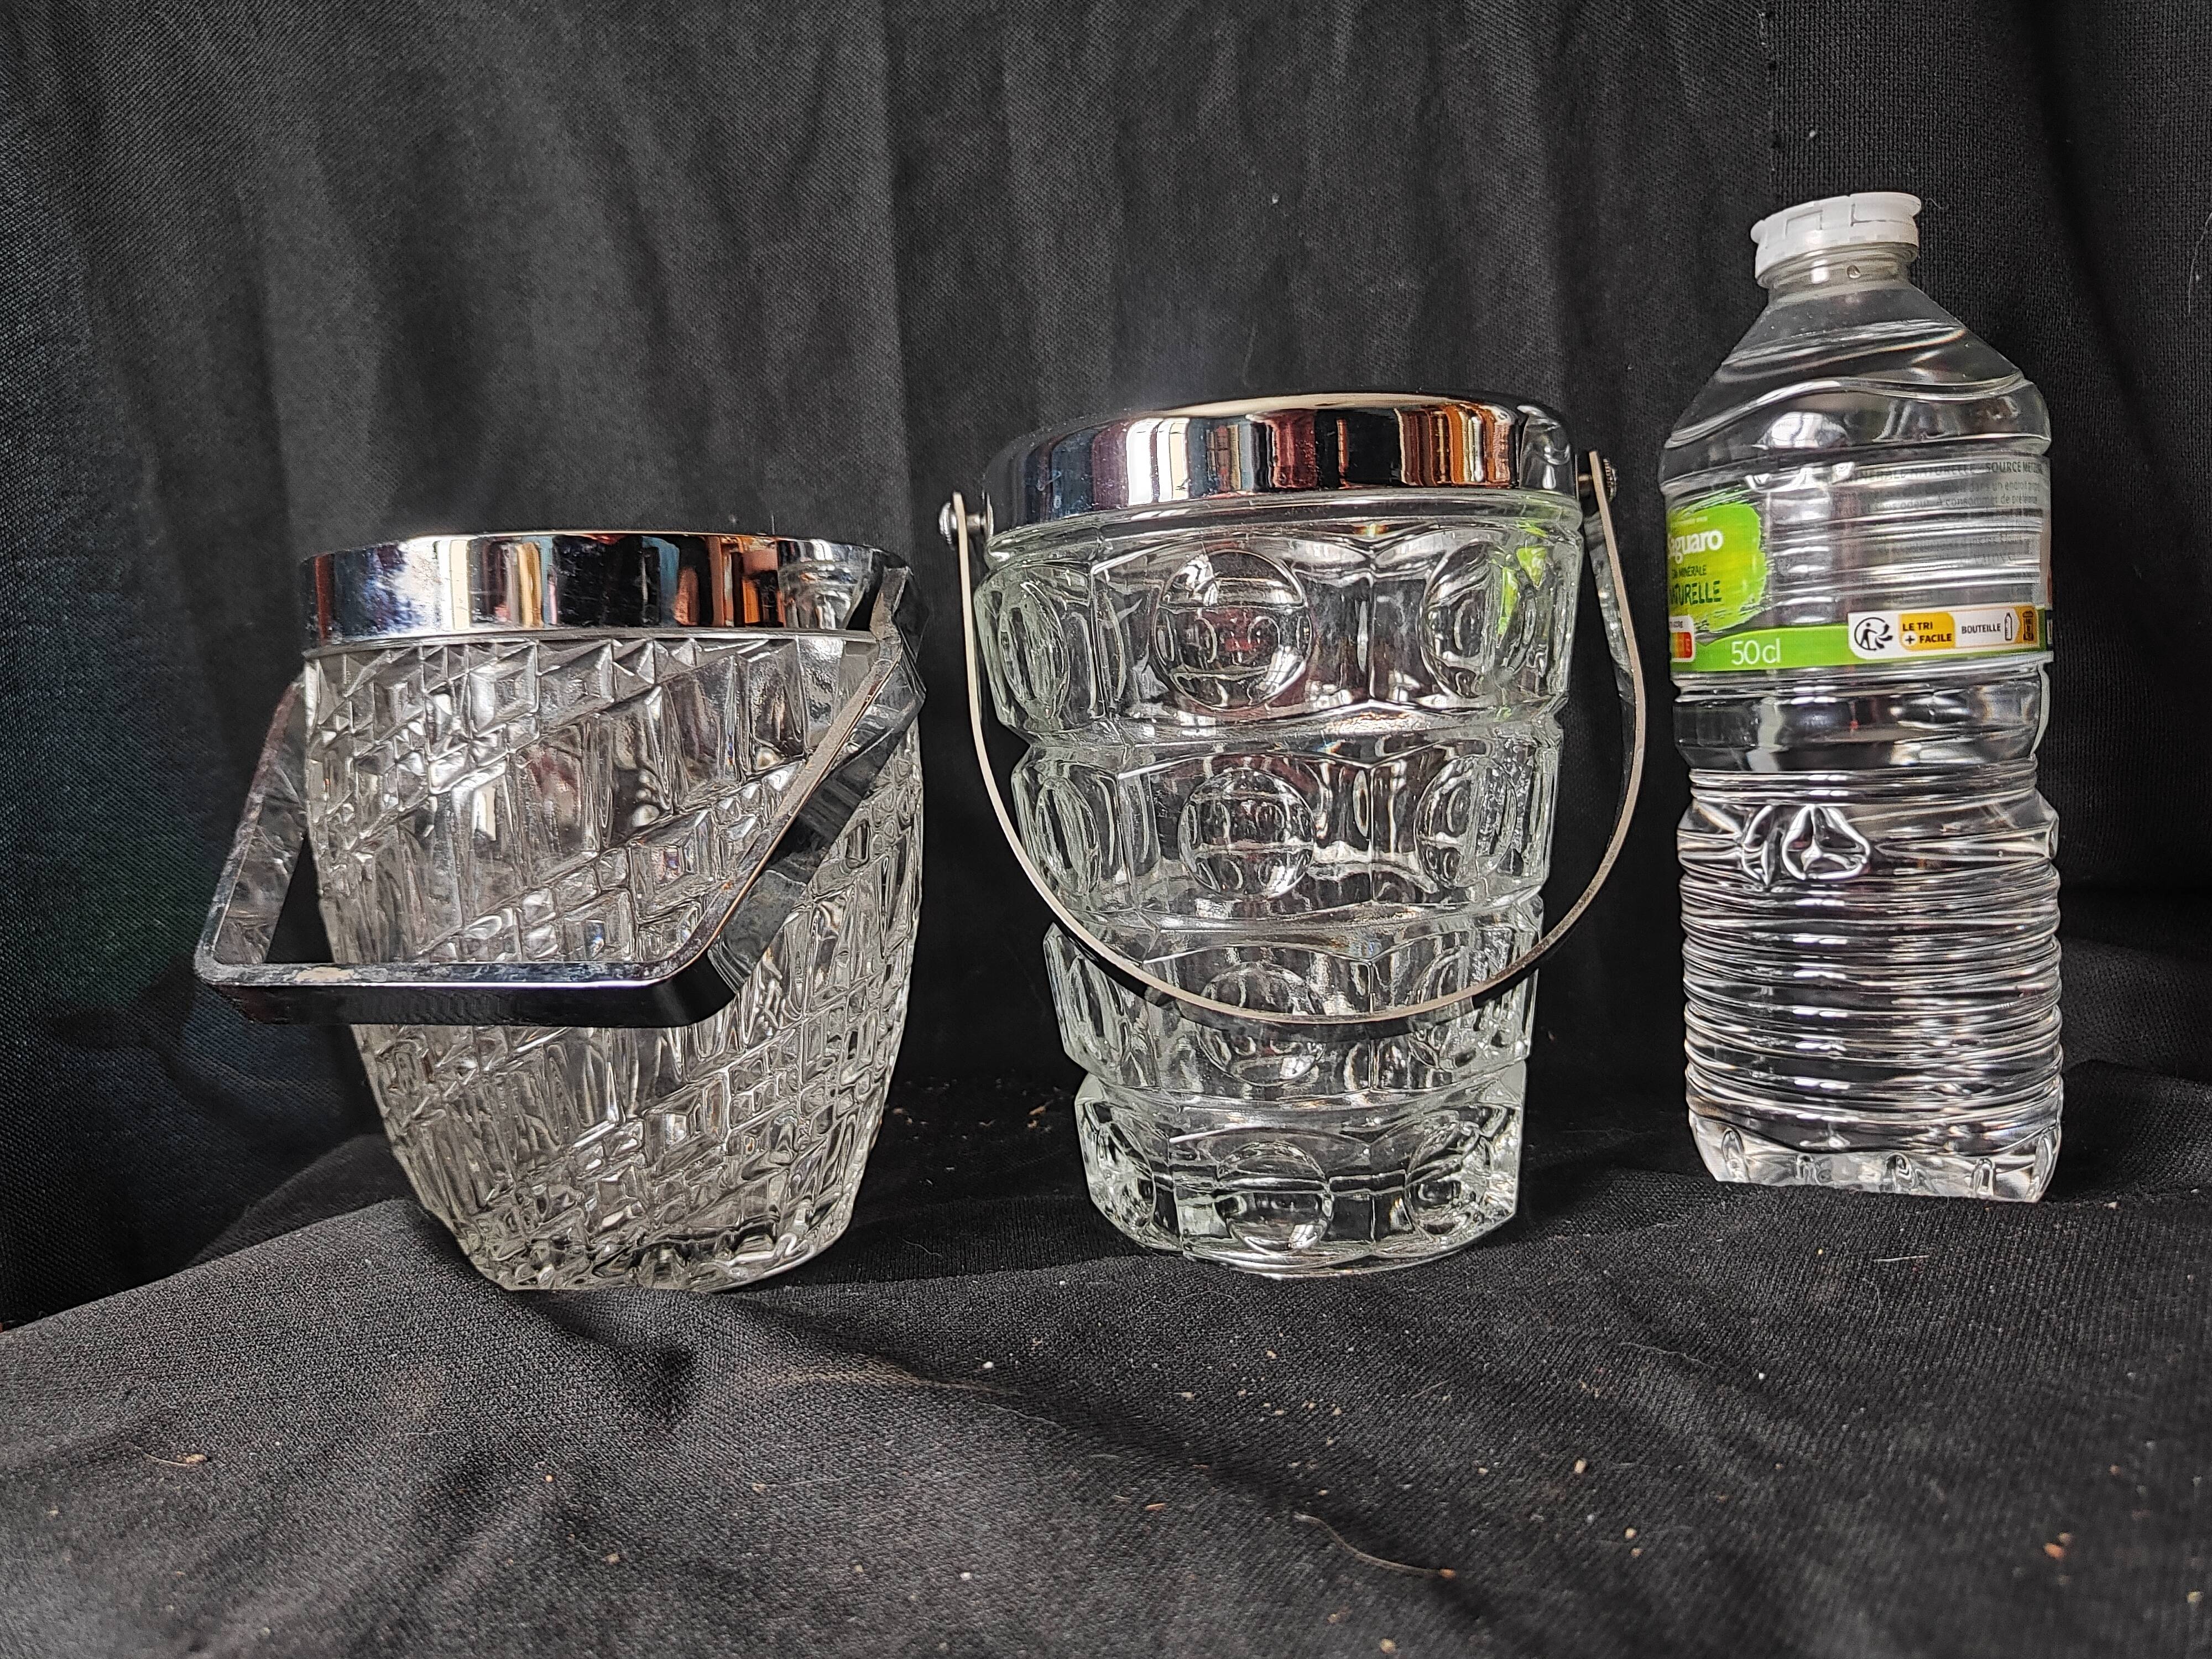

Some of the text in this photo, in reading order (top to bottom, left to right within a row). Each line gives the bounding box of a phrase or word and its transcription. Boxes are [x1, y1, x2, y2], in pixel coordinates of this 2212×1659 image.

[1985, 461, 2021, 473] SOURCE
[1902, 622, 1933, 632] LE TRI
[1961, 623, 2001, 634] BOUTEILLE
[1919, 633, 1952, 644] FACILE
